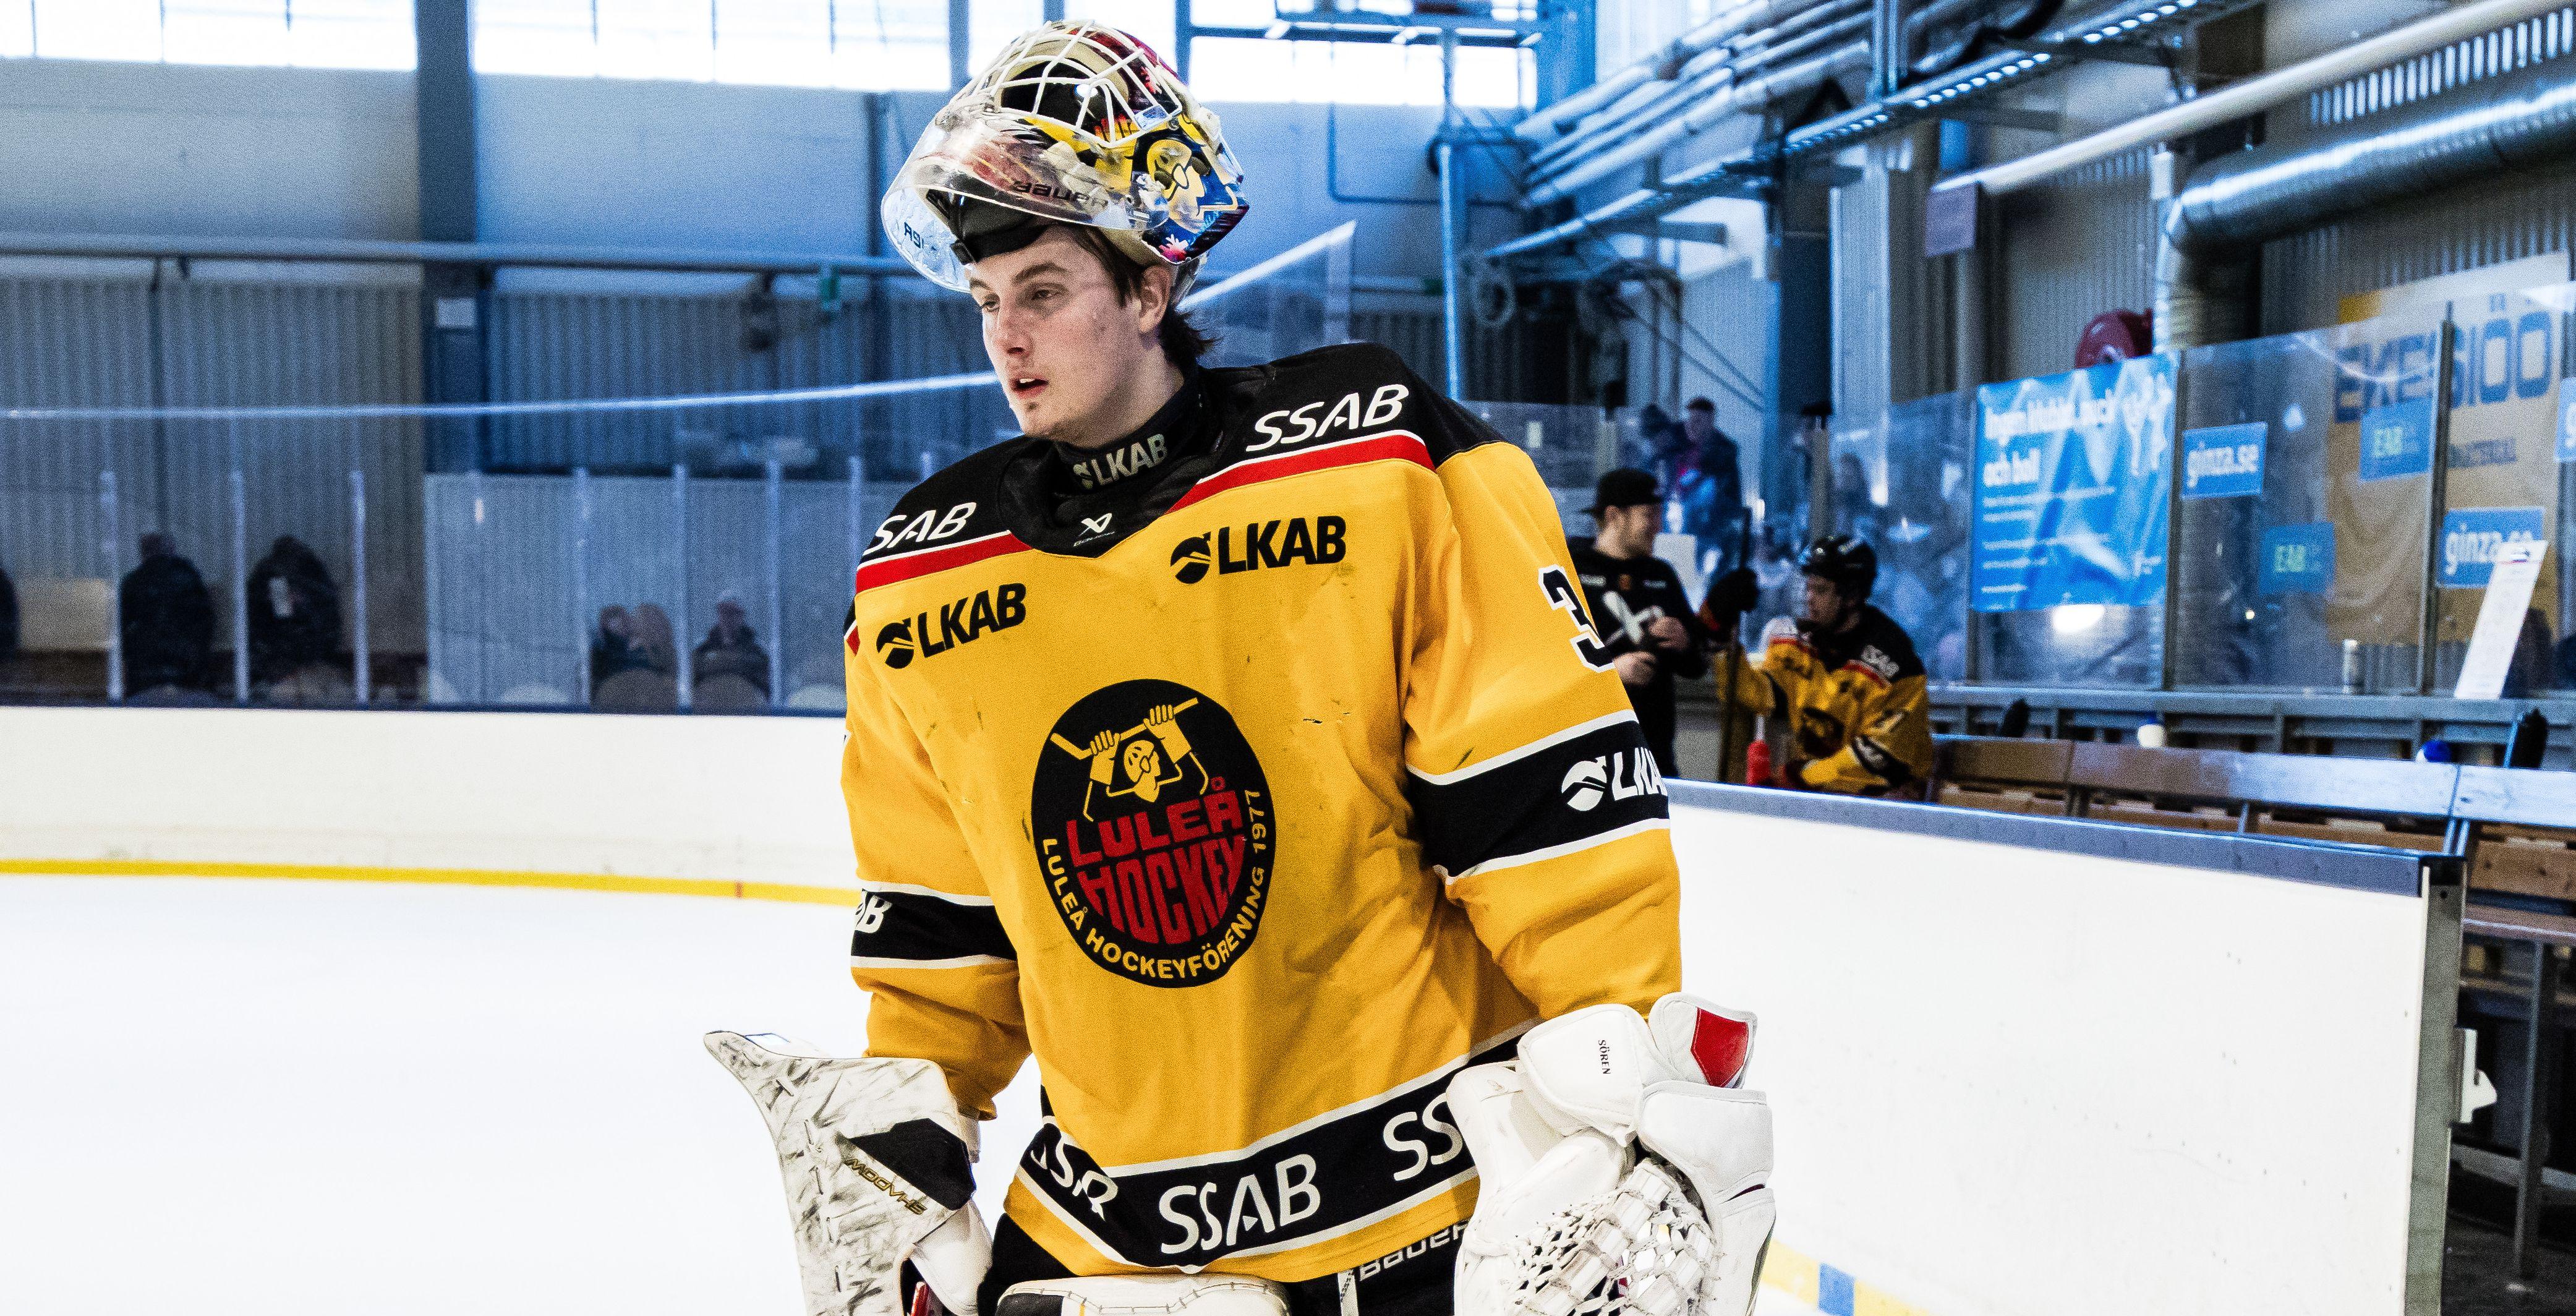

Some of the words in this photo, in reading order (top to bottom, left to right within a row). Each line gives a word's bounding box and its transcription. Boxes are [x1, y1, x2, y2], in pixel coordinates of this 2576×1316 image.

[1245, 383, 1409, 452] SSAB
[1091, 434, 1167, 485] LKAB
[1216, 515, 1346, 575] LKAB
[2446, 523, 2533, 576] ginza
[916, 582, 1027, 659] LKAB
[1611, 746, 1668, 801] LKA
[1067, 776, 1243, 866] LULEÅ
[1043, 839, 1088, 931] LULEÅ
[1086, 867, 1265, 979] HOCKEYFÖRENING
[1245, 789, 1267, 853] 1977
[1077, 834, 1247, 944] HOCKEY
[1598, 1039, 1611, 1075] SÖREN
[843, 1158, 928, 1215] SHADOW
[1158, 1153, 1321, 1255] SSAB
